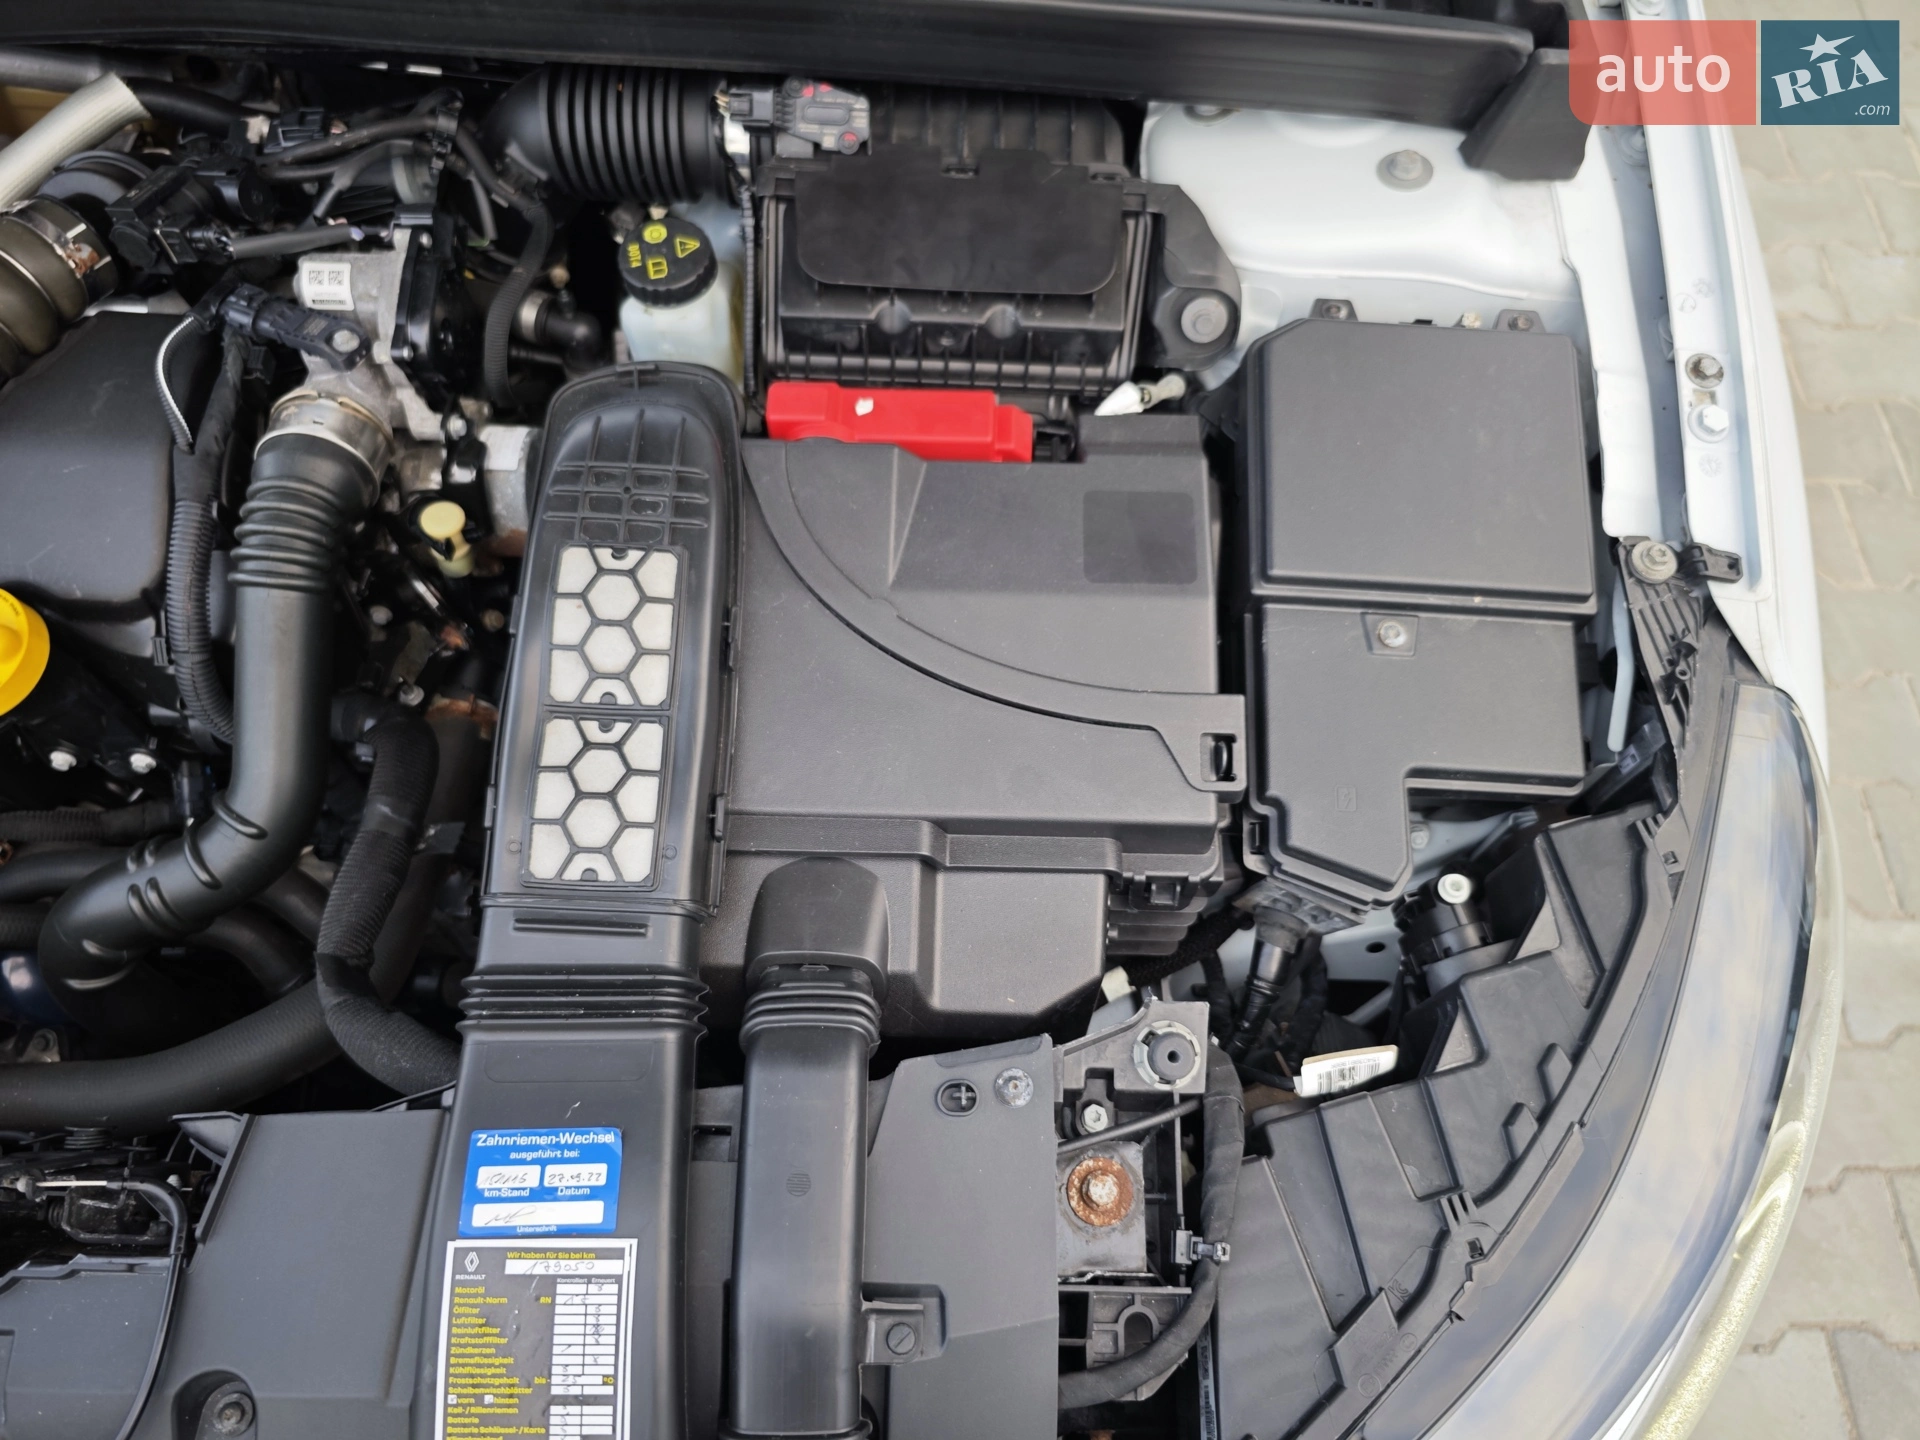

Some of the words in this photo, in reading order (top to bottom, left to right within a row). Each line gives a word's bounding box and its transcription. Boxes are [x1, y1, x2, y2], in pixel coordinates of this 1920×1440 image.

[476, 1131, 615, 1147] Zahnriemen-Wechsel
[509, 1149, 562, 1161] ausgeführt
[563, 1148, 581, 1158] bei:
[484, 1187, 530, 1198] km-Stand
[557, 1187, 590, 1196] Datum
[516, 1225, 557, 1234] Unterschrift
[507, 1251, 520, 1260] Wir
[521, 1251, 545, 1259] haben
[546, 1251, 557, 1259] für
[558, 1251, 569, 1259] Sie
[570, 1251, 582, 1259] bei
[583, 1251, 596, 1259] km
[454, 1286, 485, 1294] Motoröl
[453, 1296, 508, 1304] Renault-Norm
[539, 1296, 552, 1304] RN
[452, 1306, 480, 1314] Ölfilter
[452, 1316, 487, 1324] Luftfilter
